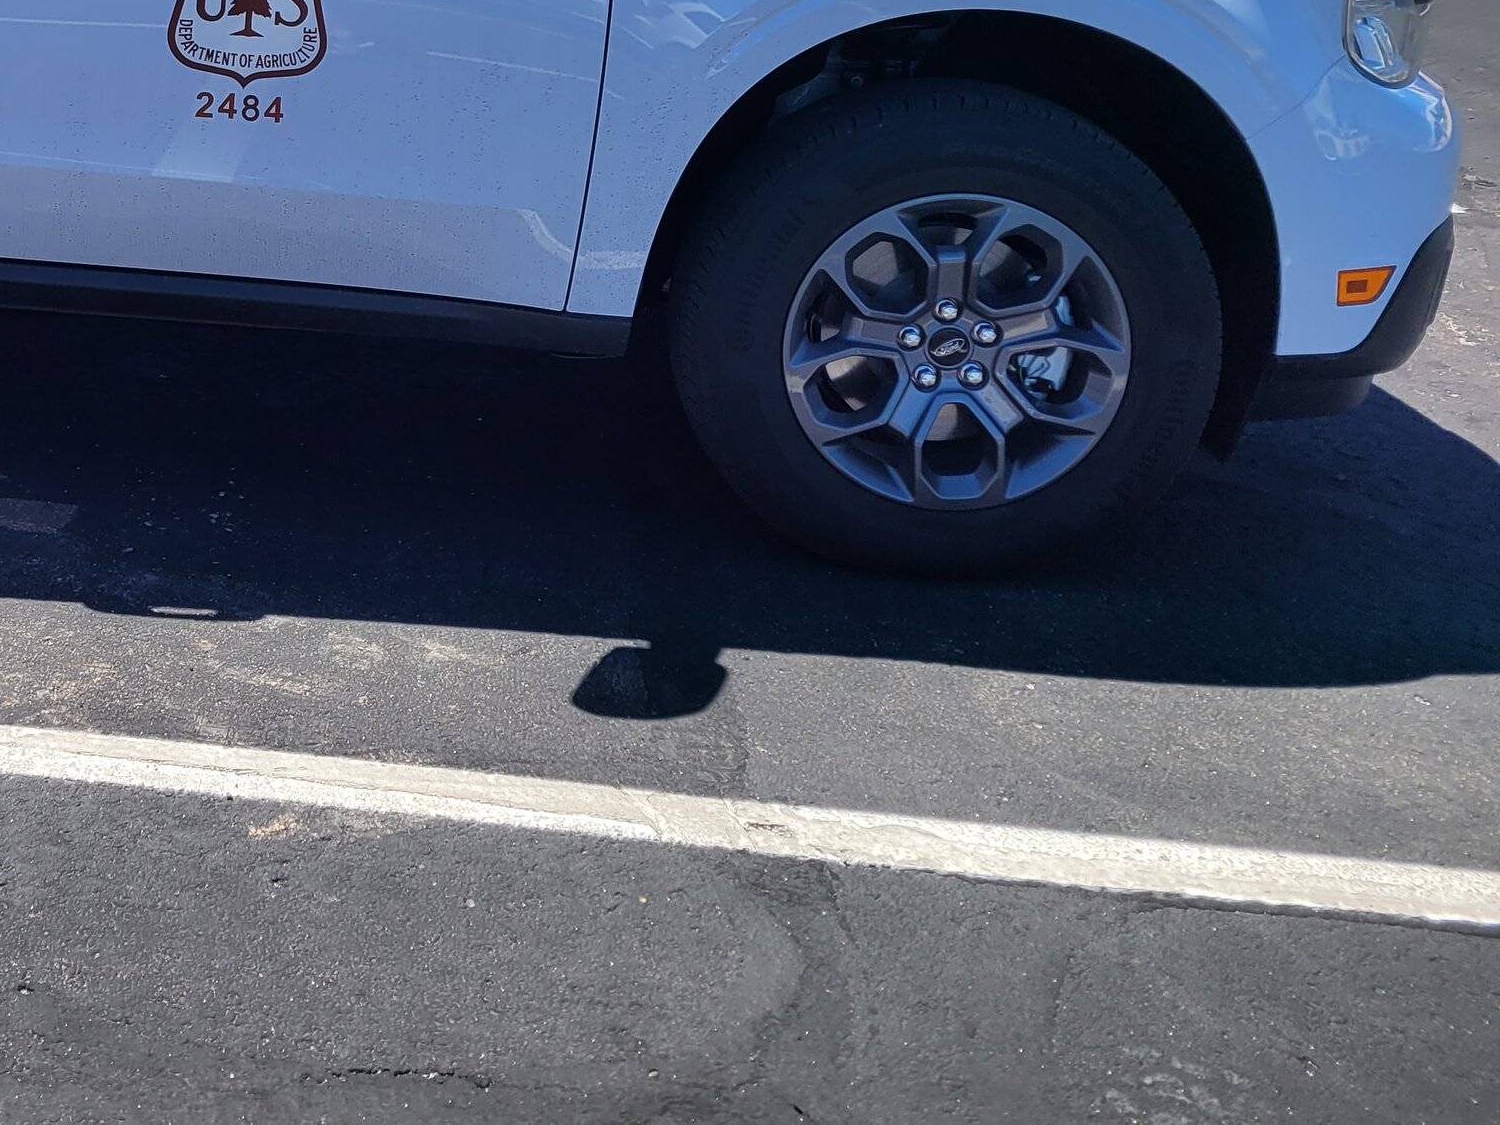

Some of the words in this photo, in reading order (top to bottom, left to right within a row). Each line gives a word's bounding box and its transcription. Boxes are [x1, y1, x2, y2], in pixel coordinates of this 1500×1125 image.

[178, 19, 239, 67] DEPARTMENT
[239, 53, 255, 68] OF
[255, 27, 318, 69] AGRICULTURE
[194, 91, 285, 124] 2484
